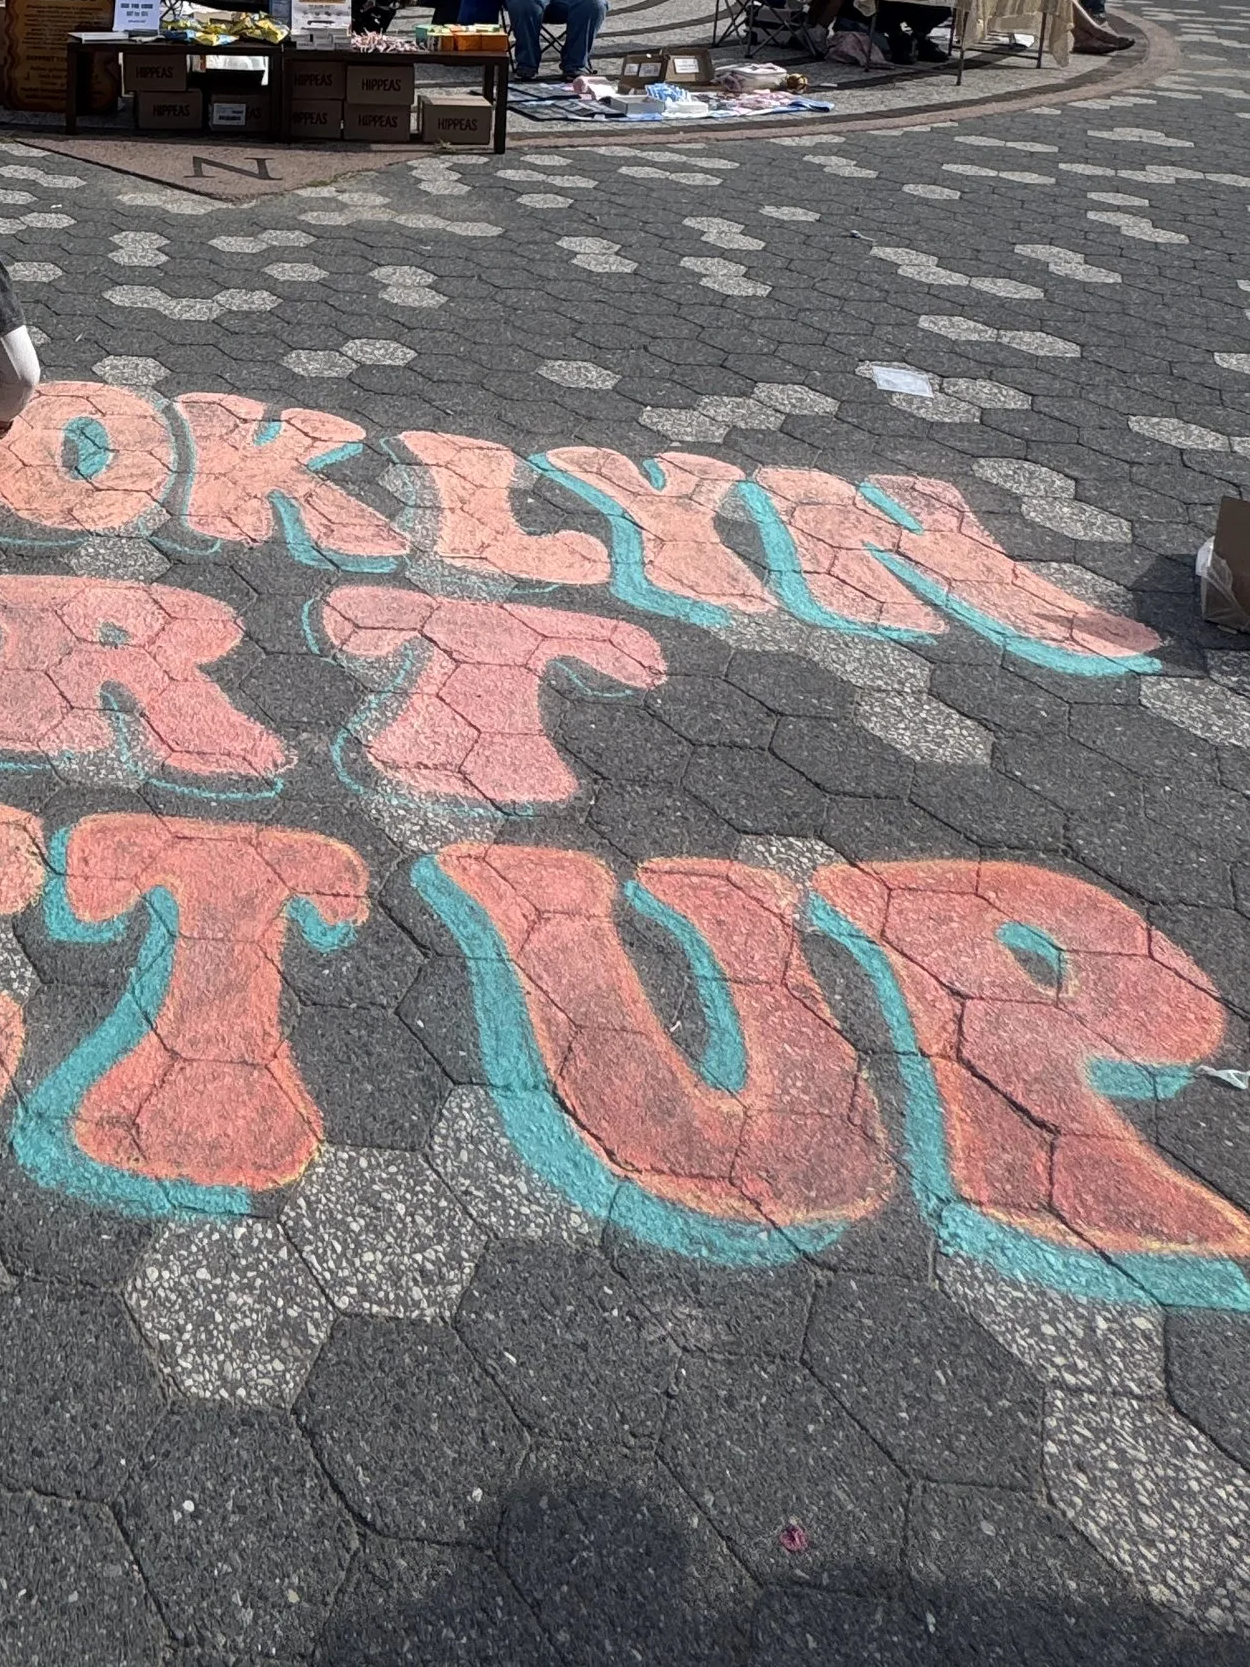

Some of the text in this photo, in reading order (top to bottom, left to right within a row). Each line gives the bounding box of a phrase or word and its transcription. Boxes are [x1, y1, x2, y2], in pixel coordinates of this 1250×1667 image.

[135, 66, 174, 79] HIPPEAS
[294, 73, 333, 87] HIPPEAS
[361, 78, 401, 92] HIPPEAS
[152, 103, 191, 117] HIPPEAS
[358, 114, 399, 128] HIPPEAS
[437, 118, 479, 131] HIPPEAS
[184, 156, 284, 181] N
